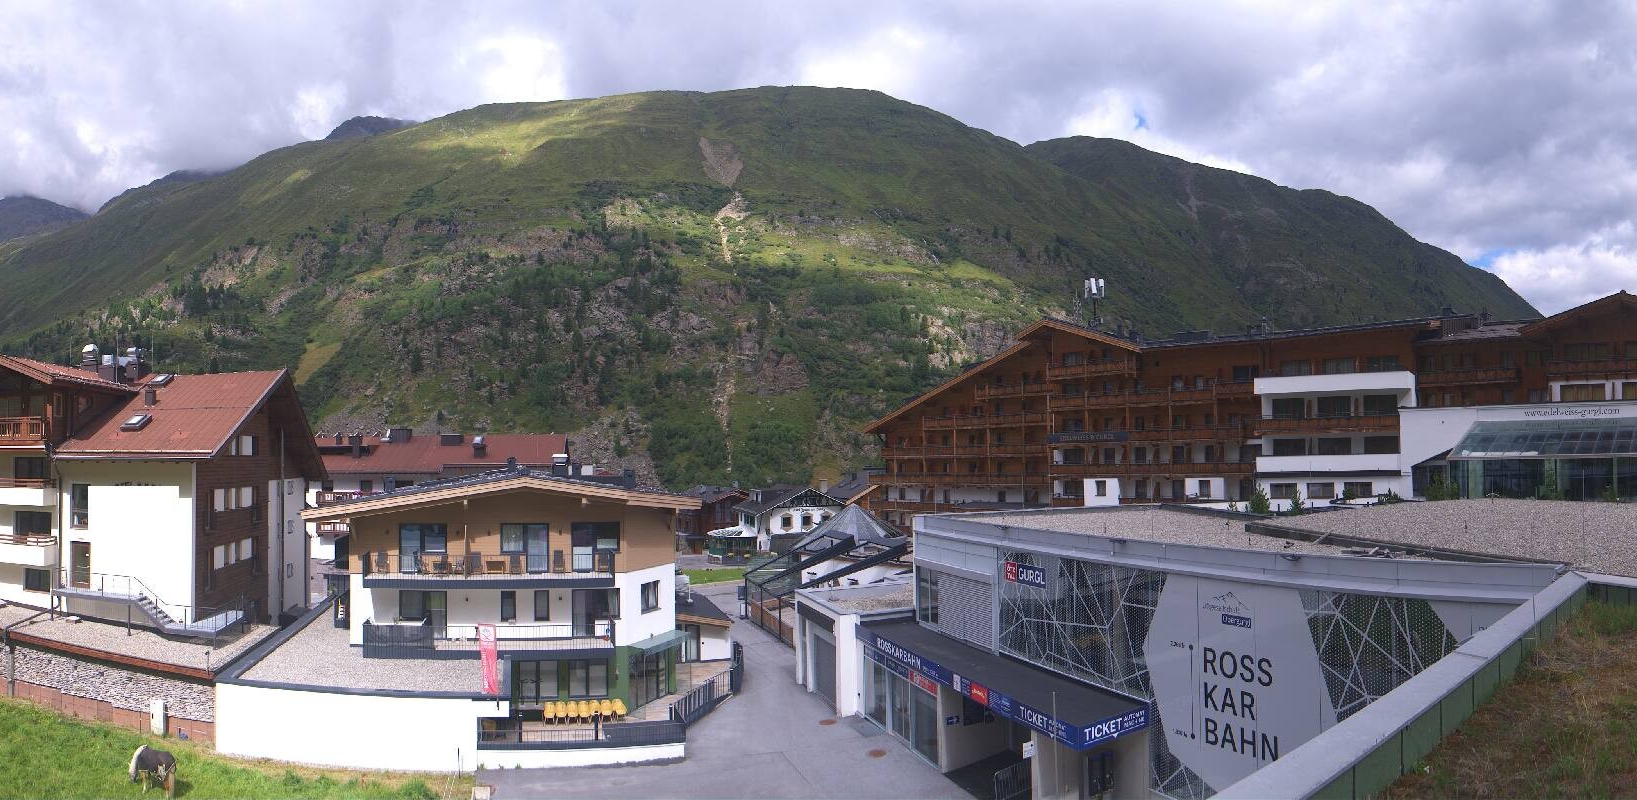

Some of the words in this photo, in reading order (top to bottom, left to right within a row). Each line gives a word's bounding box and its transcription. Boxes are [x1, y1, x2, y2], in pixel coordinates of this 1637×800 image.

[1018, 567, 1046, 585] GURGL
[876, 637, 922, 670] ROSSKARBAHN
[1203, 646, 1273, 687] ROSS
[1019, 705, 1048, 730] TICKET
[1203, 682, 1256, 721] KAR
[1083, 717, 1123, 742] TICKET
[1204, 717, 1279, 762] BAHN
